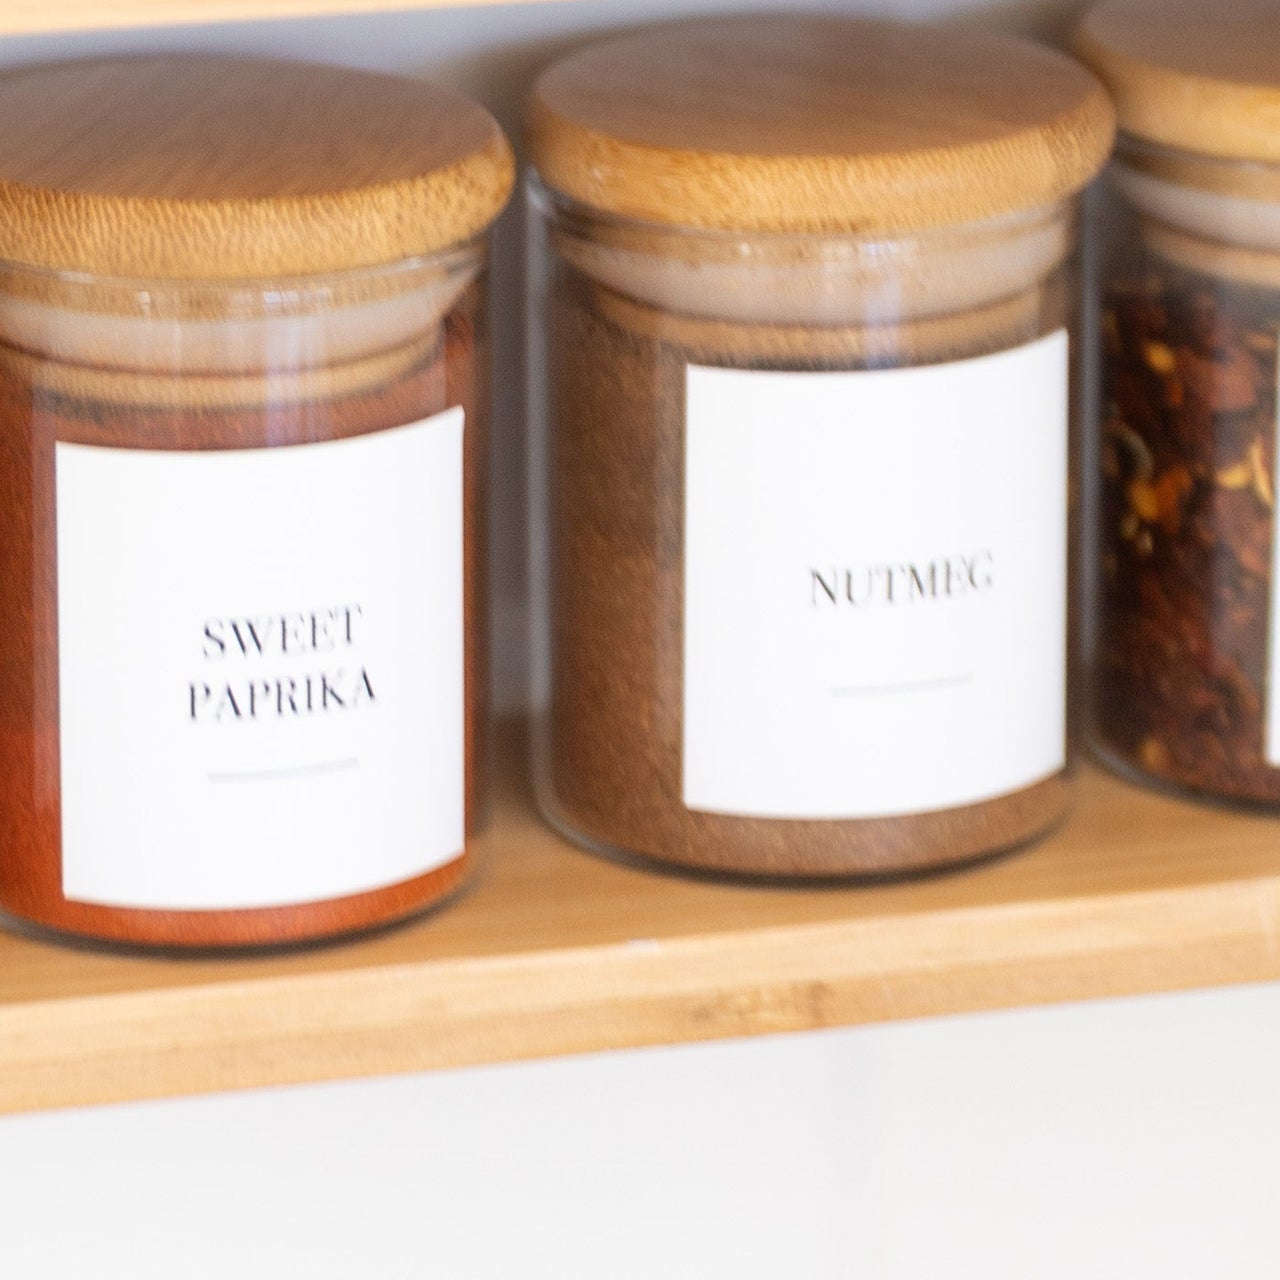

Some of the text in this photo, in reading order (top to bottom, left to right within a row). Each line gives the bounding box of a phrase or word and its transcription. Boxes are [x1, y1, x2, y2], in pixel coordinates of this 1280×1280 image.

[809, 551, 994, 605] NUTMEG
[204, 607, 362, 654] SWEET
[188, 665, 377, 721] PAPRIKA
